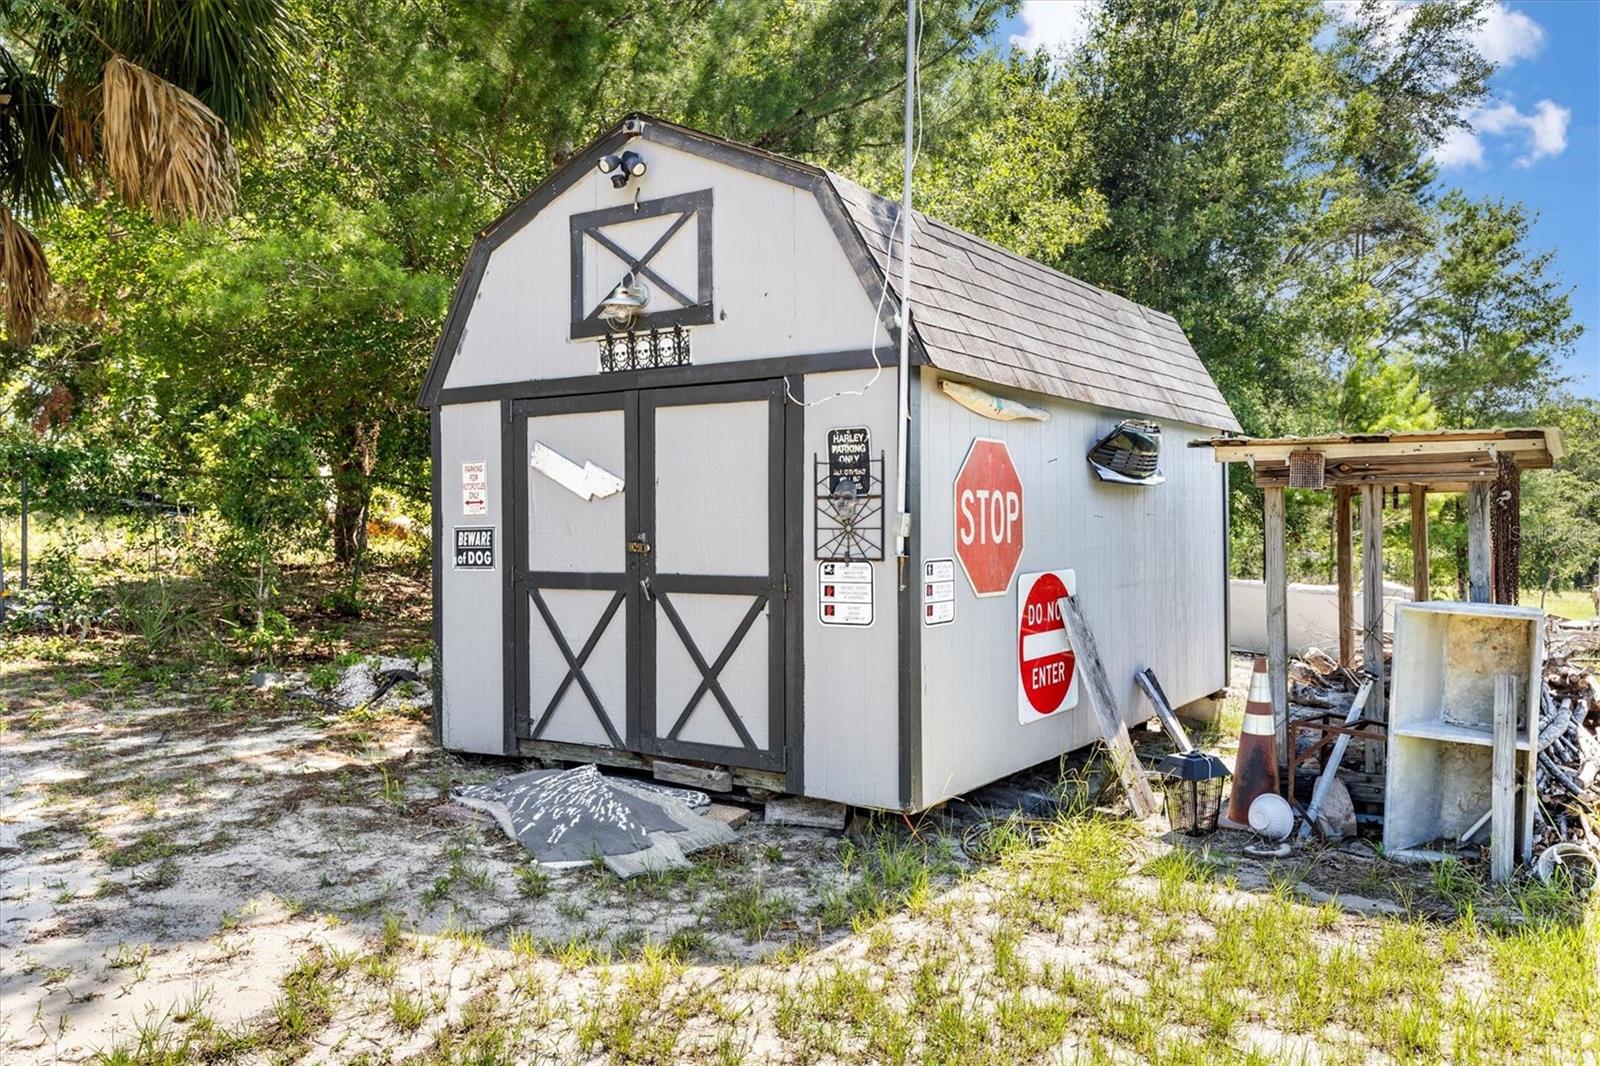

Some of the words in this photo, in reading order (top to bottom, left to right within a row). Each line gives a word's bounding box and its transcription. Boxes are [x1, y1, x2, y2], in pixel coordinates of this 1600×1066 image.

[832, 433, 864, 443] HARLEY
[831, 444, 866, 454] PARKING
[838, 455, 860, 464] ONLY
[464, 465, 483, 473] PARKING
[960, 489, 1020, 545] STOP
[458, 531, 491, 546] BEWARE
[457, 551, 467, 564] of
[467, 551, 492, 565] DOG
[1028, 604, 1042, 626] DO
[1047, 600, 1062, 621] NO
[1032, 661, 1065, 689] ENTER
